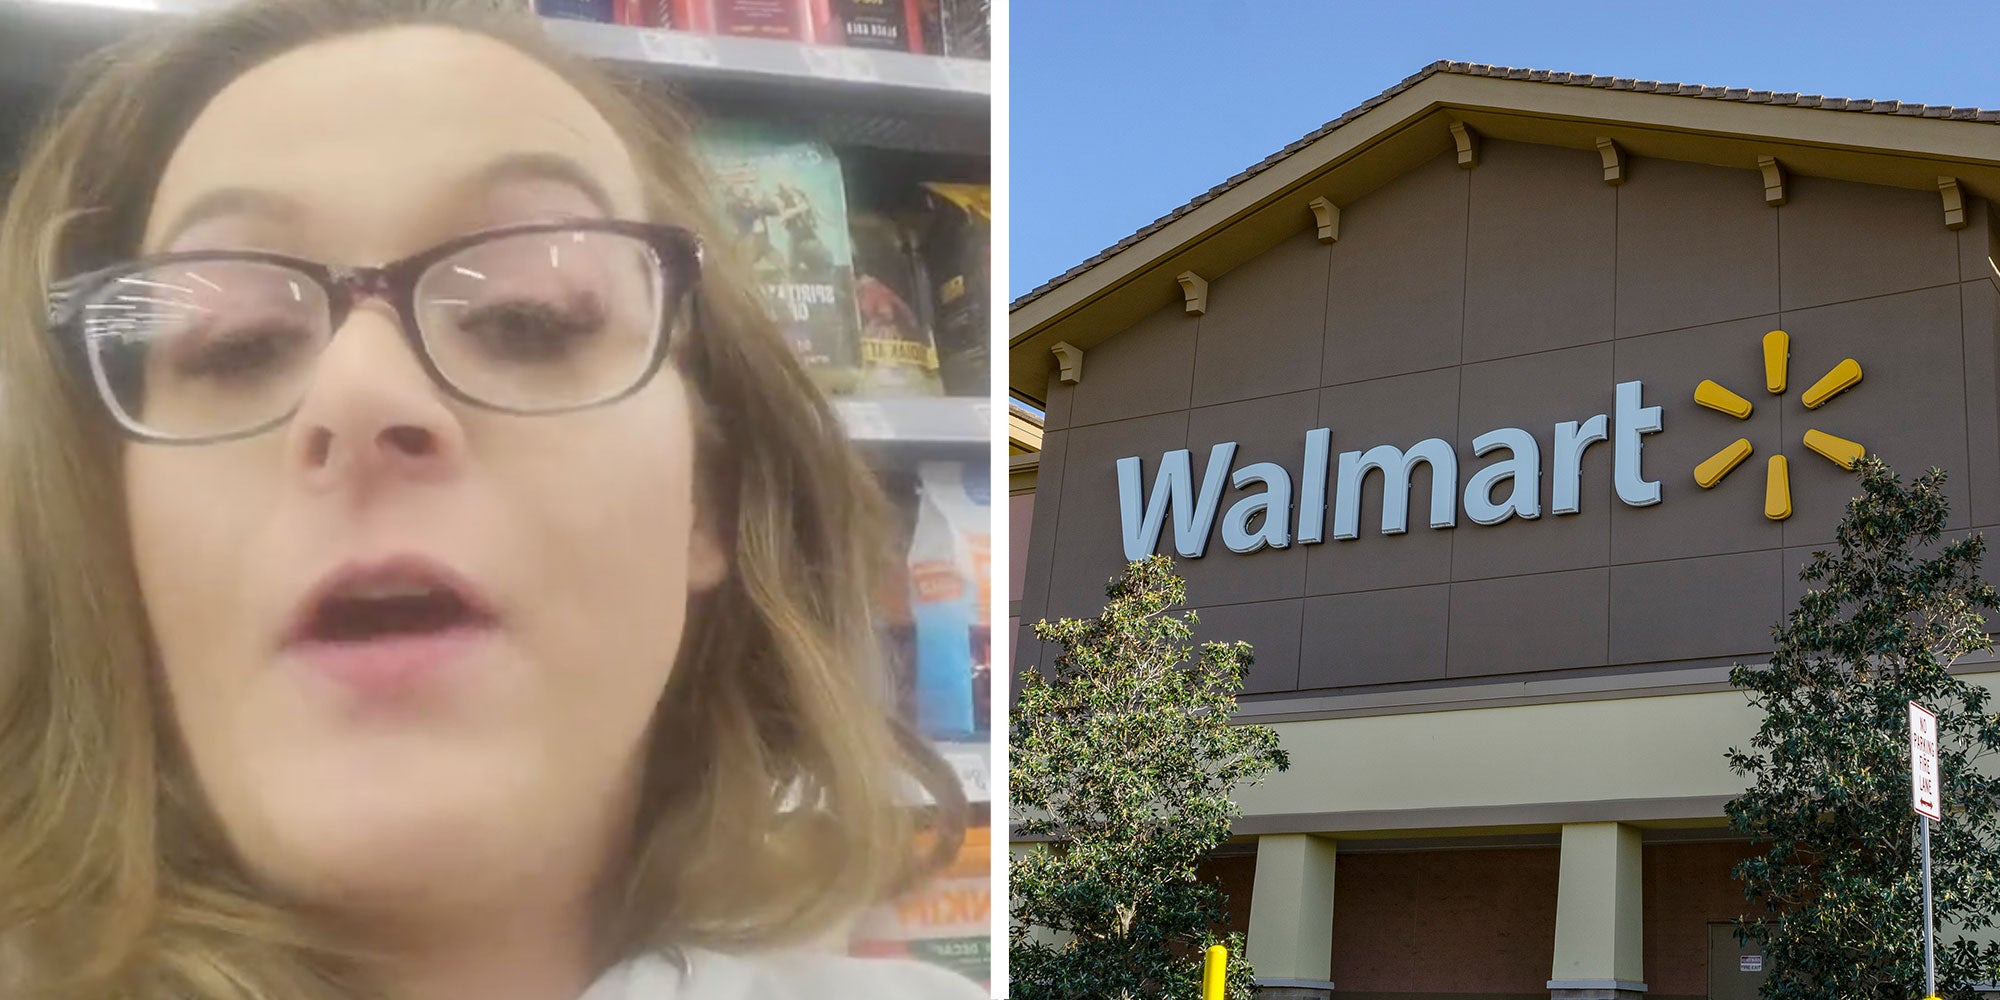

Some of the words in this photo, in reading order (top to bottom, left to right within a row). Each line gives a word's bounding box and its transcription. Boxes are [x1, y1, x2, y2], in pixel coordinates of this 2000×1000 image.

[1116, 380, 1664, 562] Walmart
[1919, 716, 1928, 734] NO
[1913, 732, 1936, 758] PARKING
[1919, 755, 1931, 775] FIRE
[1919, 775, 1932, 796] LANE
